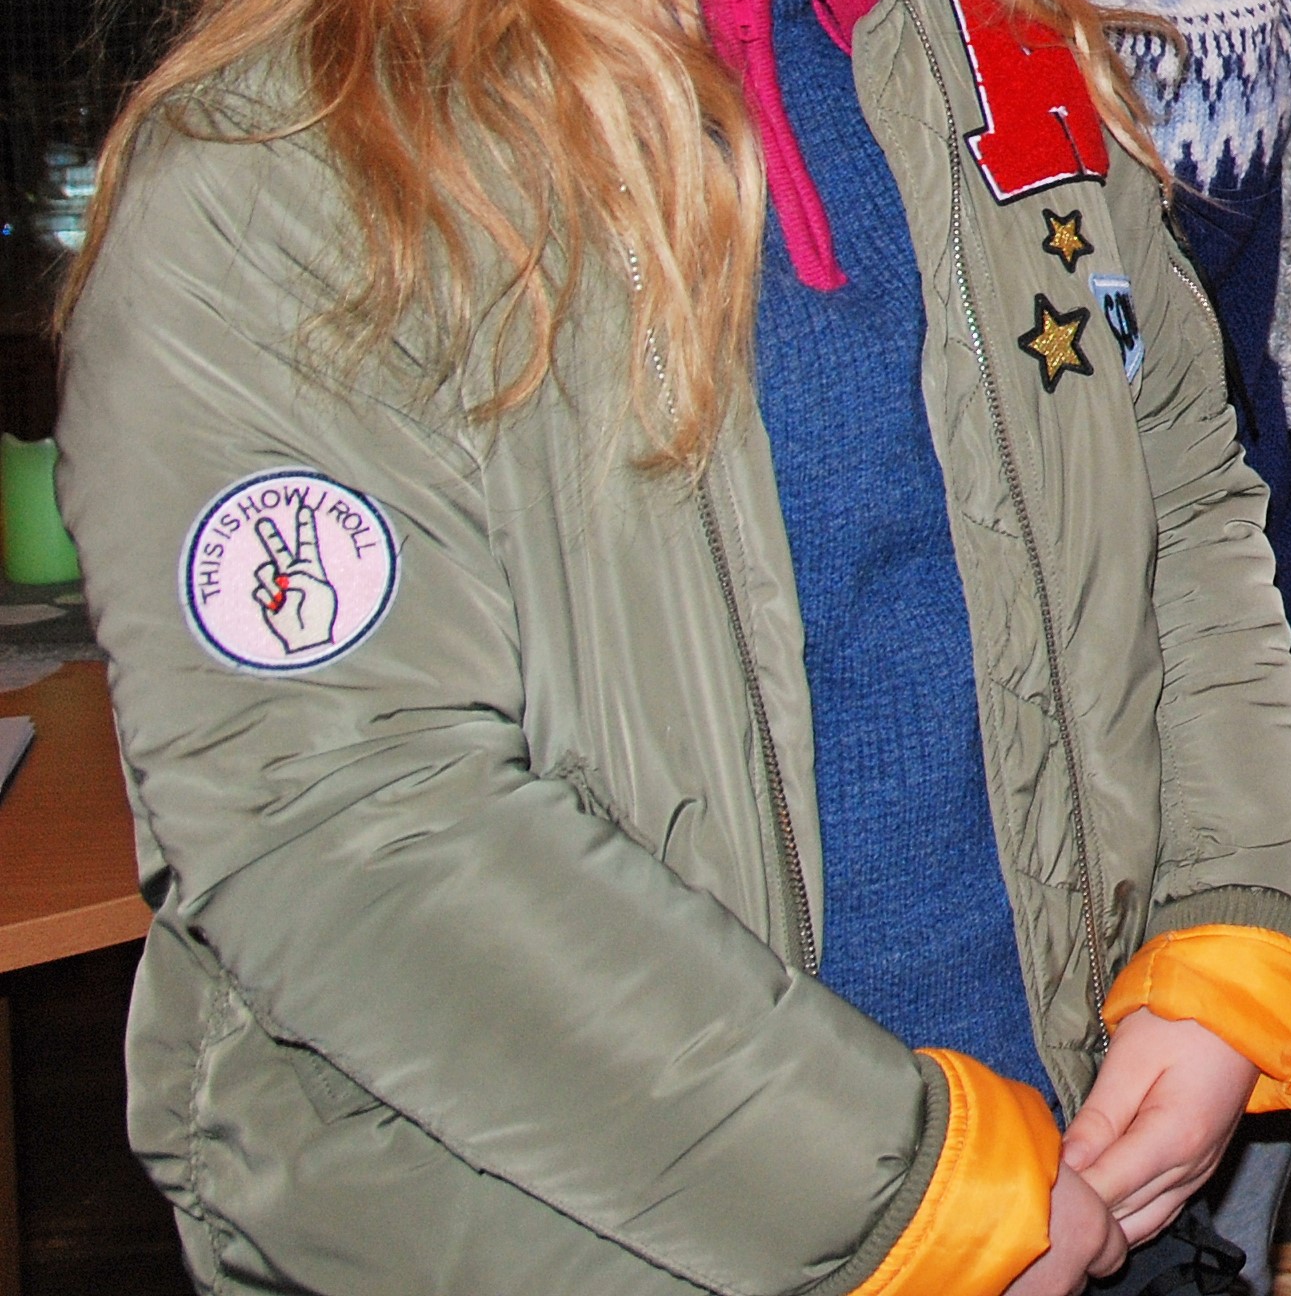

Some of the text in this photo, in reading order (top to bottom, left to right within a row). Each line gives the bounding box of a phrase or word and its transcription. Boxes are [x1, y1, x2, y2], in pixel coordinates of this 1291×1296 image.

[198, 485, 377, 605] THIS IS HOW I ROLL
